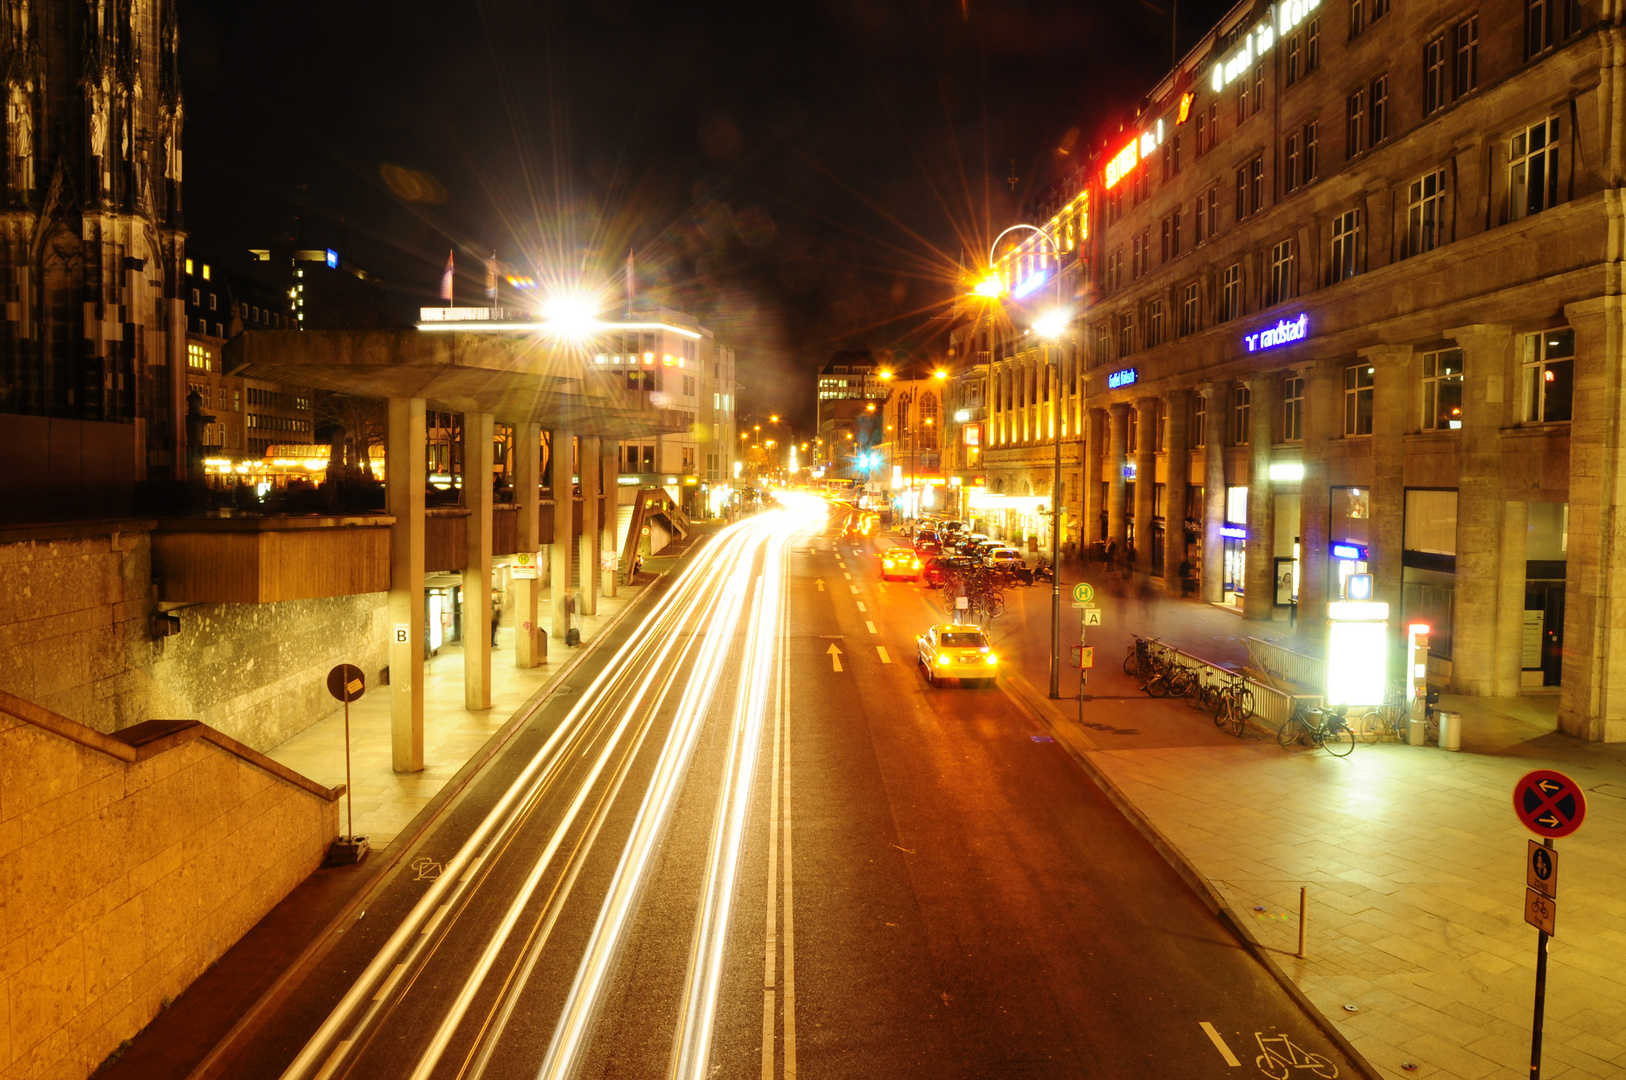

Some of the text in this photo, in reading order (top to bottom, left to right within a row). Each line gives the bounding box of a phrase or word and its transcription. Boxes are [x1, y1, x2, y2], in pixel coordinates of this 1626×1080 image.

[1260, 313, 1305, 348] randstad
[1079, 587, 1088, 598] H
[1351, 577, 1368, 599] U
[1089, 614, 1098, 624] A
[397, 629, 407, 642] B
[1534, 879, 1549, 892] ZONE
